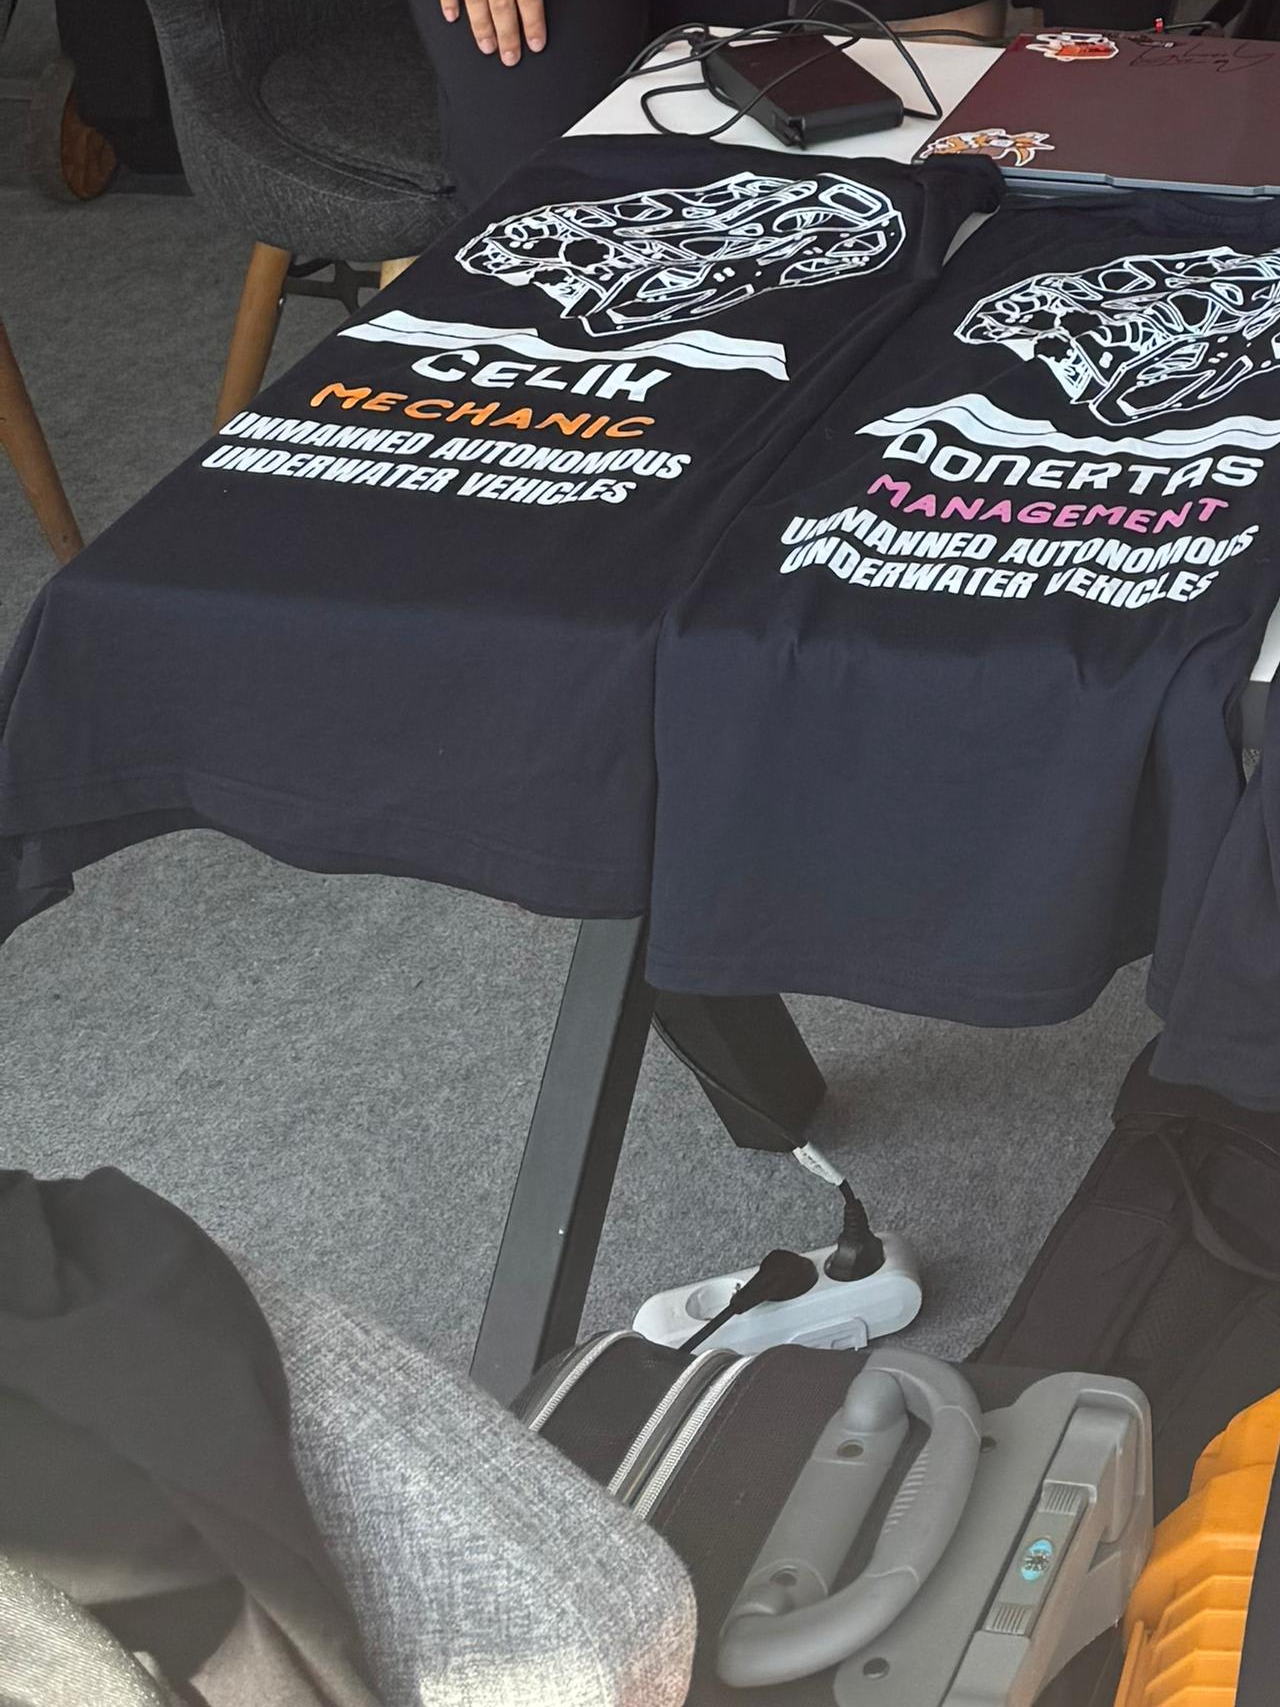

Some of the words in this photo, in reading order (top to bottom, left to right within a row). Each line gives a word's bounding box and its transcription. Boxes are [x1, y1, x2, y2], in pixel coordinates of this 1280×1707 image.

[311, 383, 654, 438] MECHANIC
[202, 444, 459, 495] UNDERWATER
[461, 472, 636, 506] VEHICLES
[219, 411, 434, 457] UNMANNED
[444, 437, 691, 480] AUTONOMOUS
[866, 474, 1229, 534] MANAGEMENT
[781, 507, 995, 560] UNMANNED
[1006, 525, 1259, 573] AUTONOMOUS
[780, 538, 1036, 599] UNDERWATER
[1044, 568, 1218, 609] VEHICLES
